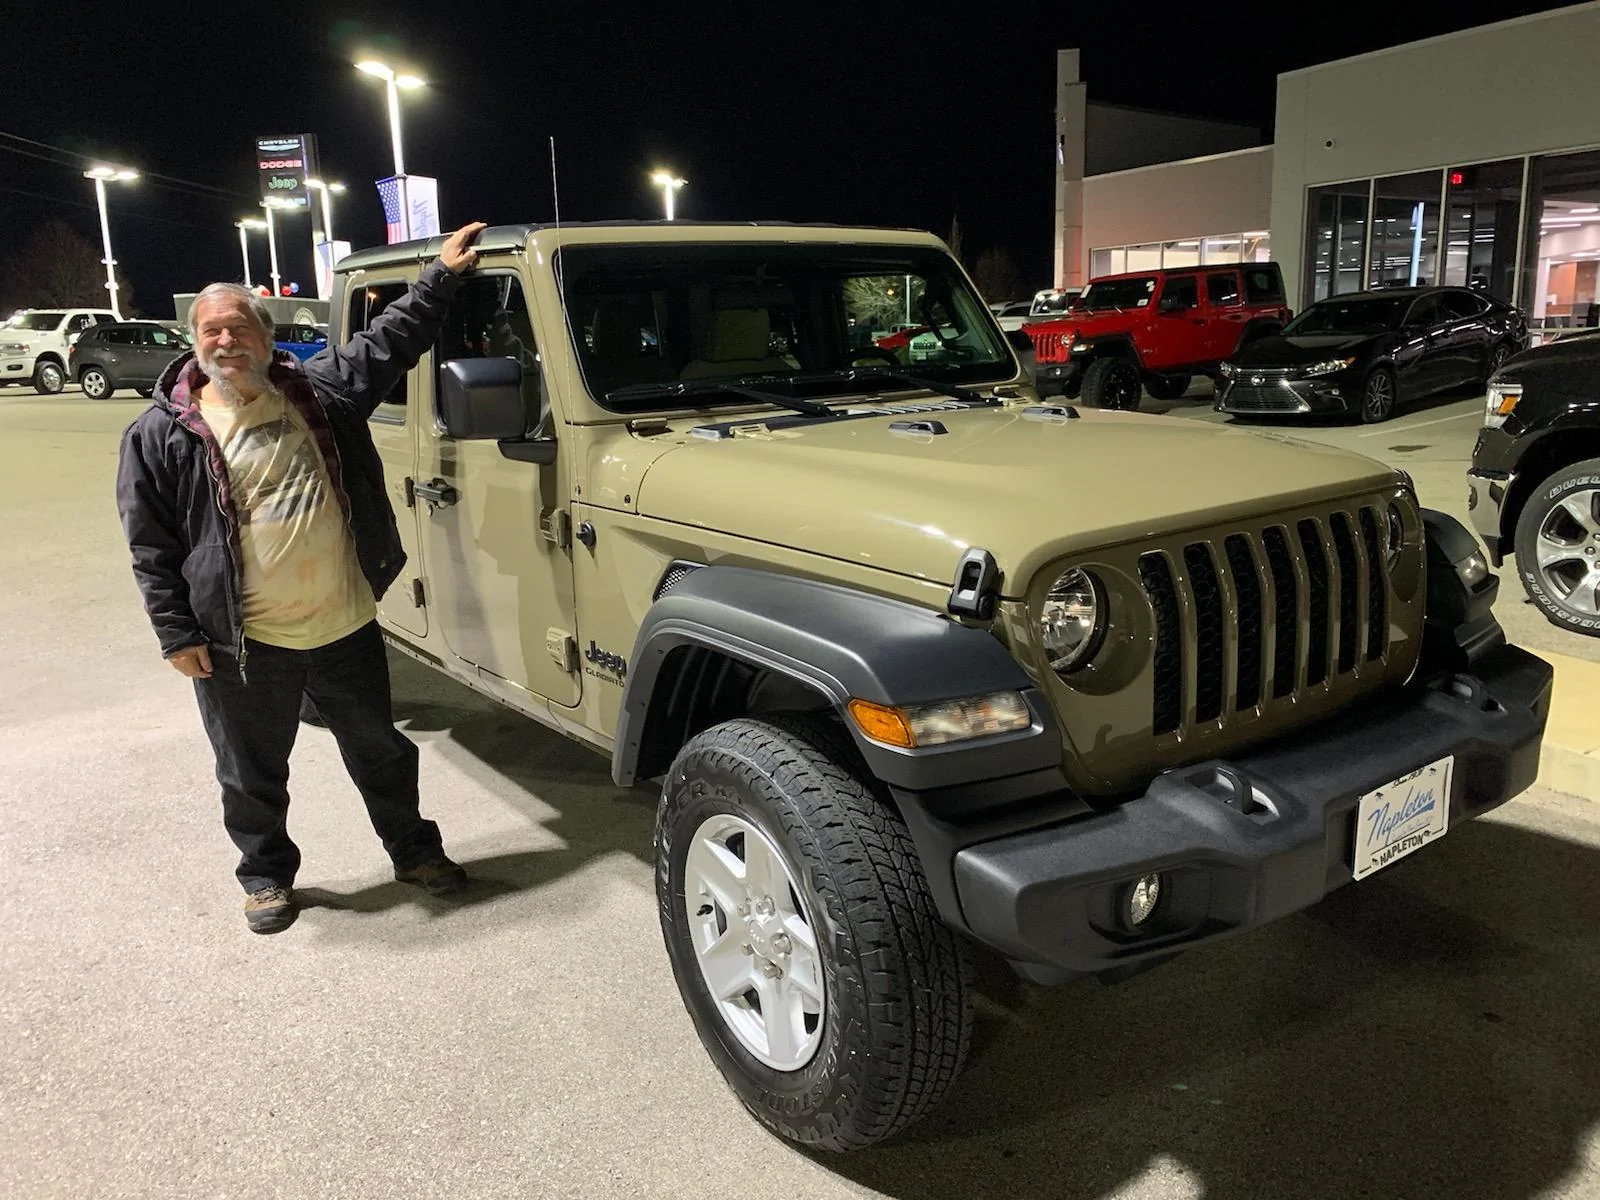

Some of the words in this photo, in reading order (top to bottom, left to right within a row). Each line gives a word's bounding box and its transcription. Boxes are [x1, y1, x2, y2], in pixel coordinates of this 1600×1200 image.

[260, 160, 302, 169] DODGE
[268, 176, 298, 190] Jeep
[1549, 476, 1600, 499] DUEL
[585, 640, 627, 680] Jeep
[586, 667, 624, 687] GLADIATO
[1366, 785, 1433, 847] Napleton
[1380, 834, 1424, 866] NAPLETON
